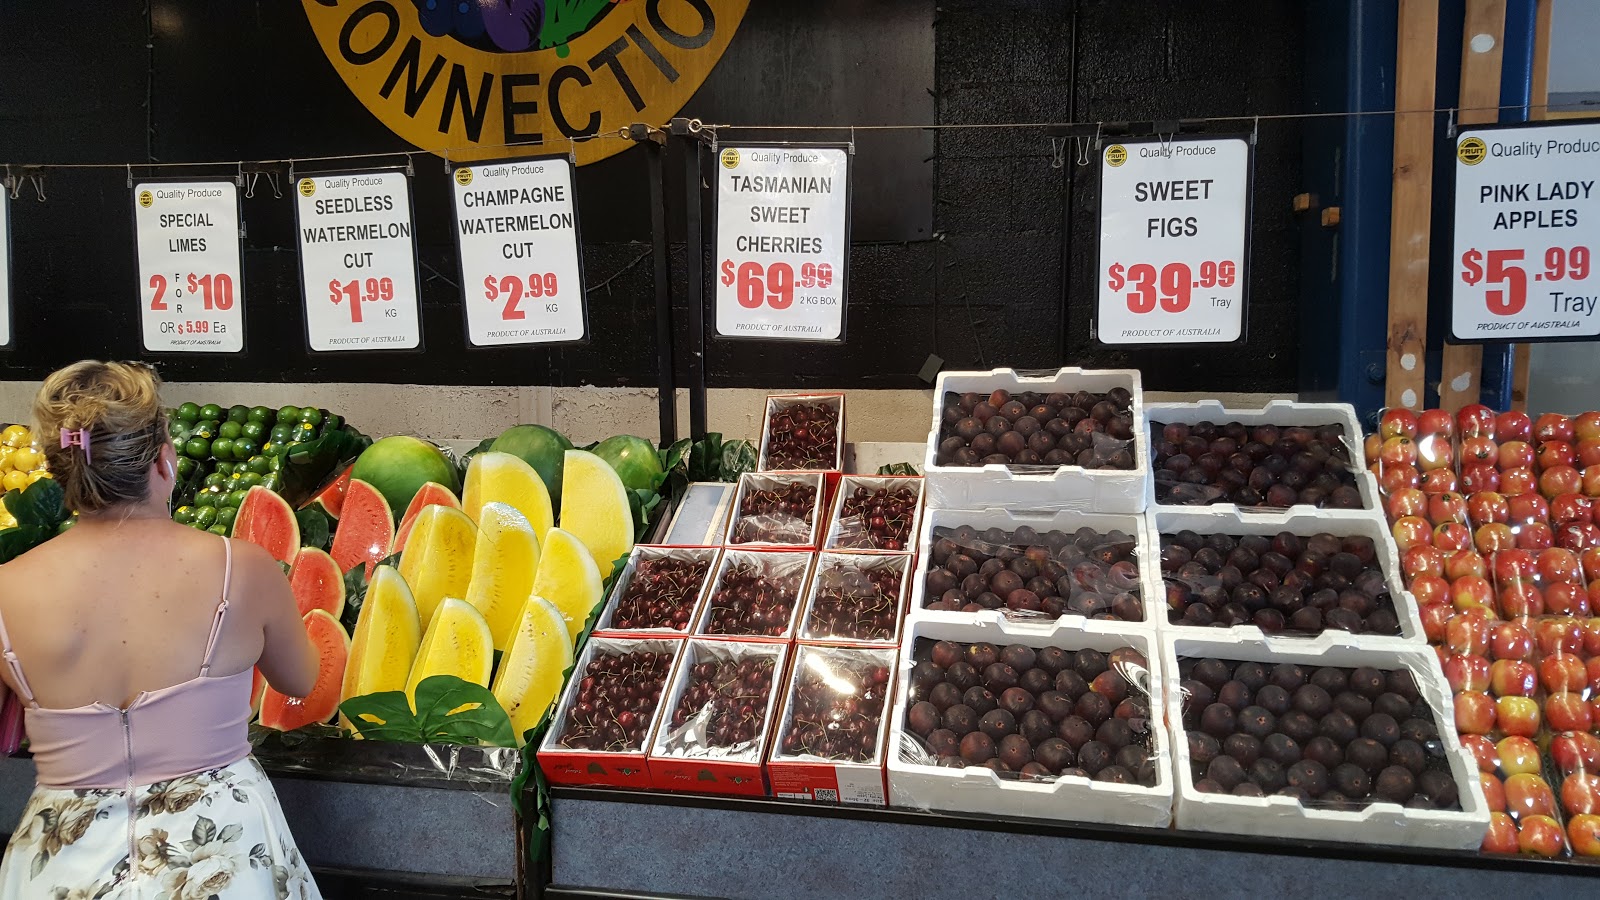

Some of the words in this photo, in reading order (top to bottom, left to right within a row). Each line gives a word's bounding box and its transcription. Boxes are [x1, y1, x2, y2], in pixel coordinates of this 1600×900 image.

[315, 0, 715, 145] ONNECTIO
[751, 152, 780, 164] Quality
[784, 152, 818, 162] Produce
[1140, 147, 1174, 160] Quality
[1176, 146, 1216, 156] Produce
[1491, 142, 1542, 158] Quality
[482, 167, 510, 178] Quality
[512, 165, 544, 175] Produce
[324, 179, 350, 190] Quality
[352, 177, 382, 186] Produce
[731, 176, 832, 194] TASMANIAN
[1134, 180, 1214, 202] SWEET
[1480, 184, 1530, 203] PINK
[1537, 180, 1595, 201] LADY
[156, 190, 185, 200] Quality
[188, 188, 222, 198] Produce
[464, 186, 565, 208] CHAMPAGNE
[315, 195, 393, 215] SEEDLESS
[160, 213, 214, 228] SPECIAL
[460, 212, 572, 235] WATERMELON
[750, 206, 810, 224] SWEET
[1493, 209, 1578, 230] APPLES
[303, 222, 410, 244] WATERMELON
[1148, 216, 1198, 238] FIGS
[169, 238, 206, 252] LIMES
[502, 242, 534, 260] CUT
[736, 236, 822, 254] CHERRIES
[344, 252, 374, 268] CUT
[150, 274, 168, 310] 2
[187, 272, 233, 310] $10
[721, 258, 832, 310] $69.99
[1108, 260, 1236, 314] $39.99
[328, 277, 394, 322] $1.99
[484, 272, 558, 320] $2.99
[800, 296, 804, 304] 2
[806, 296, 818, 304] KG
[820, 296, 837, 306] BOX
[1210, 297, 1232, 308] Tray
[1550, 292, 1598, 316] Tray
[384, 308, 397, 318] KG
[546, 304, 558, 312] KG
[160, 322, 175, 333] OR
[213, 322, 226, 333] Ea
[487, 330, 518, 338] PRODUCT
[530, 328, 566, 336] AUSTRALIA
[772, 324, 782, 332] OF
[783, 325, 822, 333] AUSTRALIA
[1176, 328, 1221, 336] AUSTRALIA
[1476, 322, 1516, 330] PRODUCT
[1517, 322, 1530, 330] OF
[1530, 320, 1580, 329] AUSTRALIA
